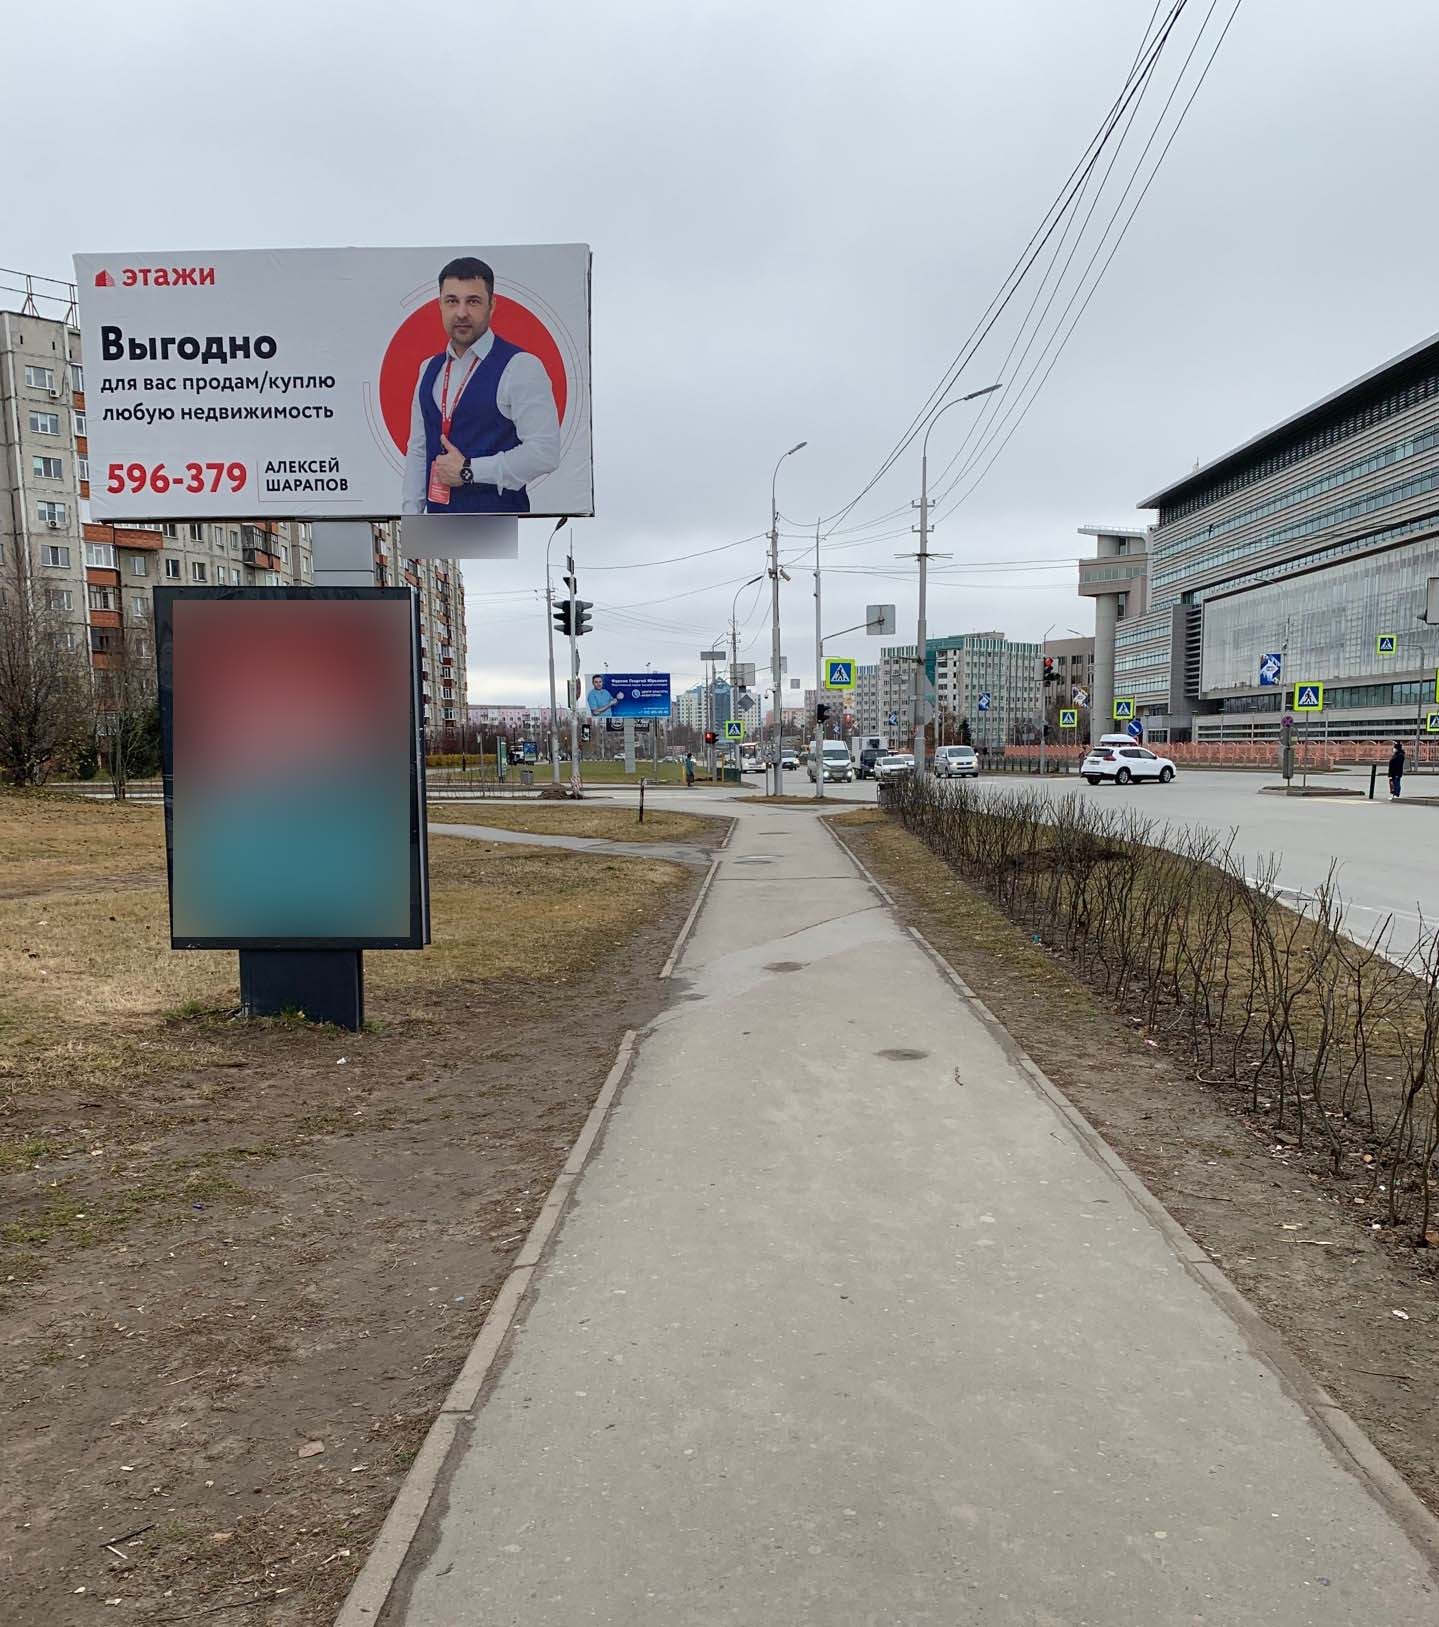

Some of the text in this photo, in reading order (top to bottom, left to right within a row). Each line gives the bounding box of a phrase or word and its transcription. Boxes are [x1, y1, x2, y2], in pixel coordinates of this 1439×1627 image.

[123, 268, 214, 286] этажи
[101, 326, 277, 364] Выгодно
[101, 371, 335, 394] для вас продам/куплю
[103, 402, 333, 424] любую недвижимость
[265, 457, 339, 473] АЛЕКСЕЙ
[107, 463, 246, 493] 596-379
[267, 479, 348, 491] ШАРАПОВ
